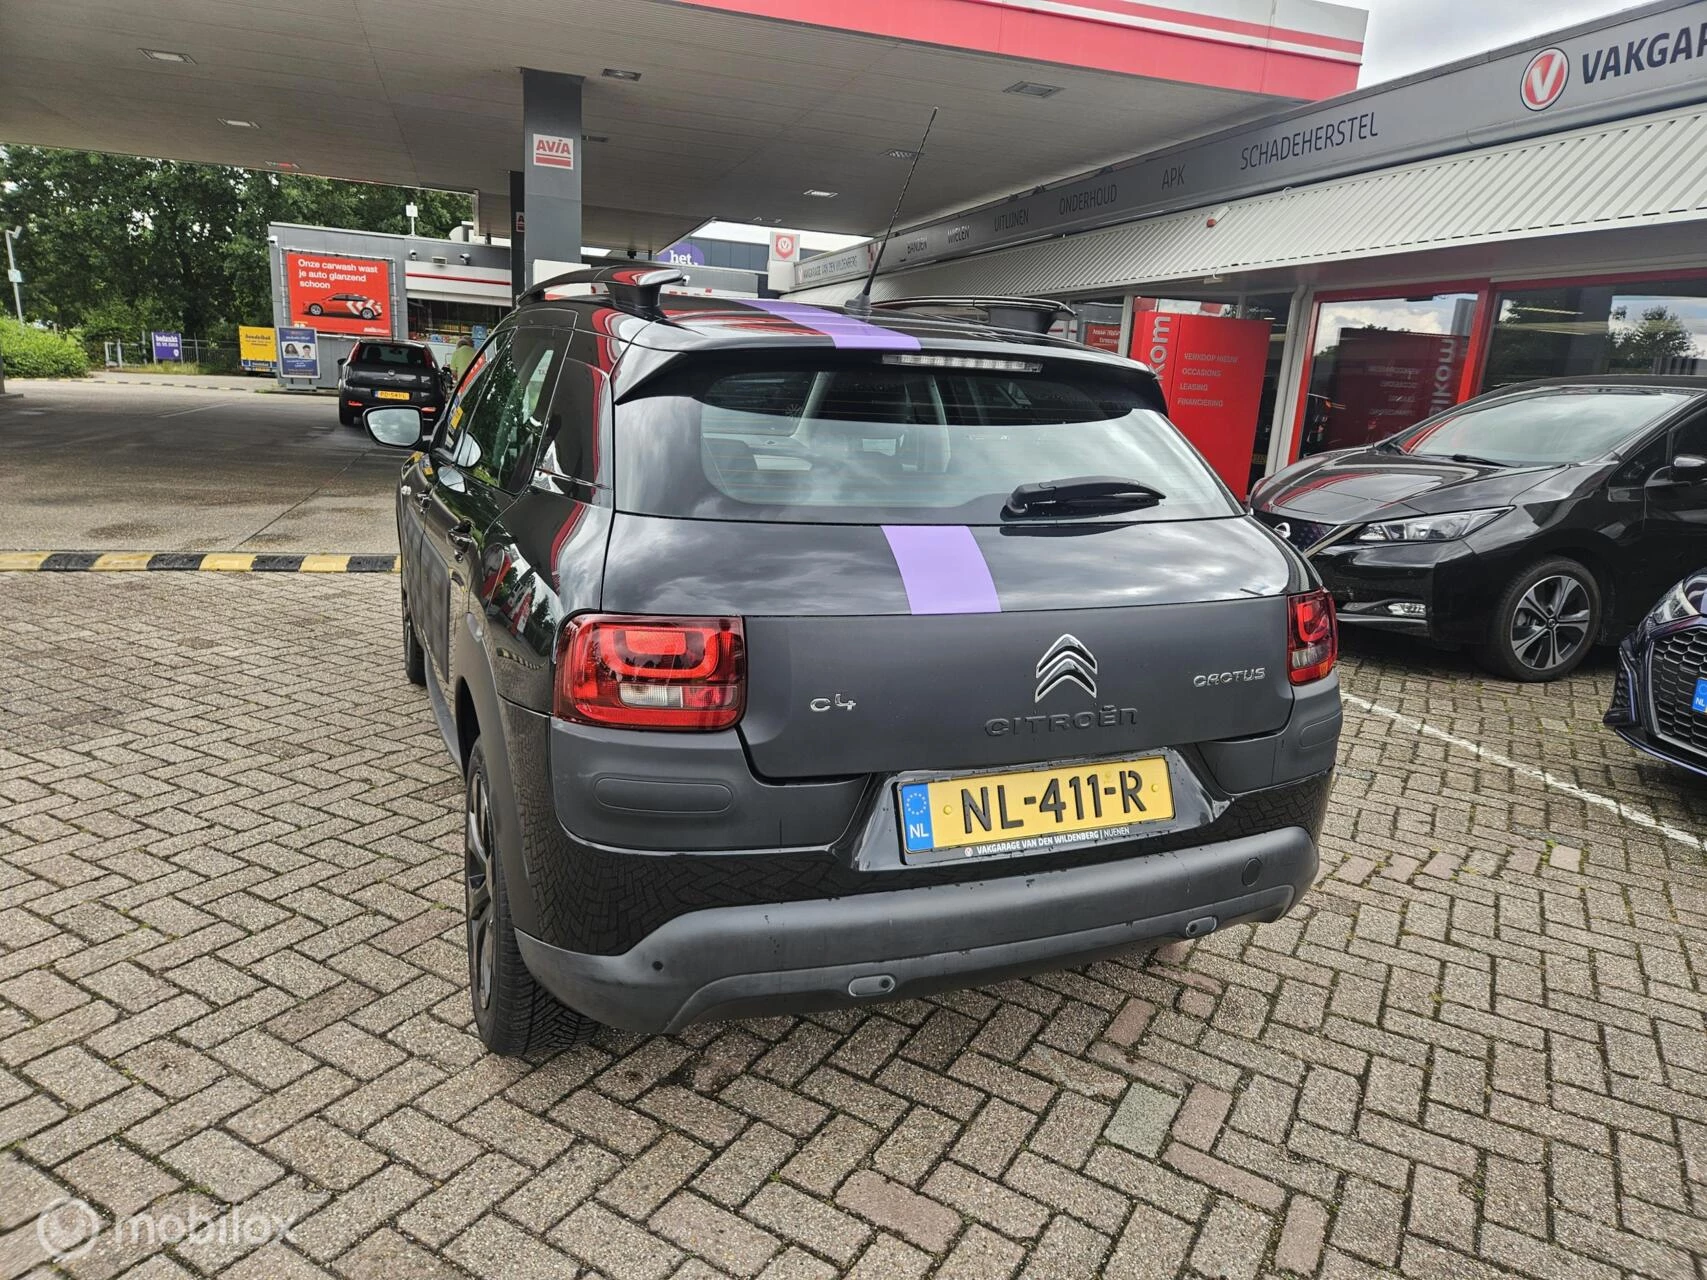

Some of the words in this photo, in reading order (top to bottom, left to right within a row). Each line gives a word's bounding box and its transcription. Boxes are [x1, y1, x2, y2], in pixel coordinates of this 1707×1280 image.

[536, 139, 571, 155] AVIA
[1240, 111, 1378, 170] SCHADEHERSTEL
[1161, 164, 1186, 190] APK
[1060, 184, 1118, 215] ONDERHOUD
[947, 226, 970, 244] WIELEN
[298, 259, 320, 269] Onze
[321, 262, 357, 271] carwash
[358, 265, 378, 273] wast
[299, 269, 307, 278] je
[308, 271, 328, 279] auto
[329, 272, 366, 282] glanzend
[299, 280, 331, 289] schoon
[1184, 353, 1216, 361] VERKOOP
[1182, 368, 1222, 377] OCCASIONS
[1180, 383, 1208, 391] LEASING
[1177, 398, 1223, 407] FINANCIERING
[1193, 667, 1266, 689] CACTUS
[810, 693, 857, 713] C4
[984, 704, 1139, 738] CITROËN
[961, 769, 1147, 834] NL-411-R
[909, 823, 930, 838] NL
[976, 840, 1021, 855] VAKGARAGE
[1022, 838, 1037, 850] VAN
[1038, 836, 1051, 848] DEN
[1054, 830, 1099, 845] WILDENBERG
[1104, 827, 1130, 838] NUENEN
